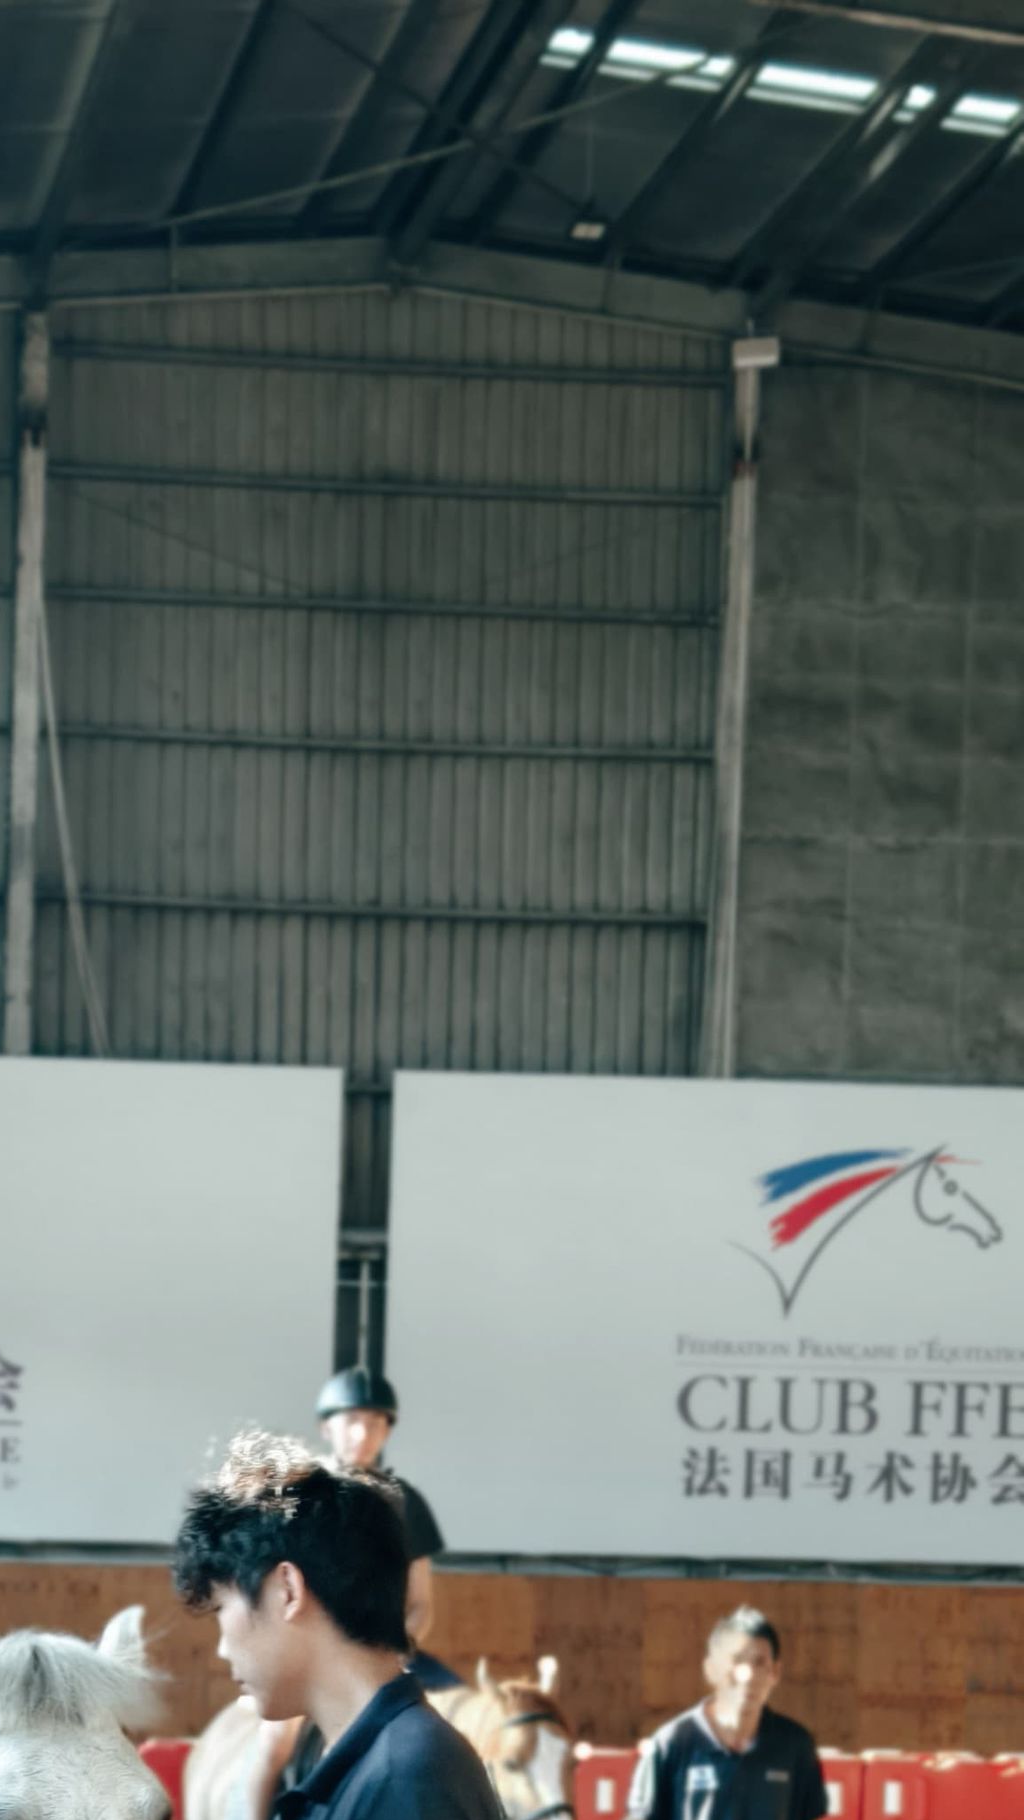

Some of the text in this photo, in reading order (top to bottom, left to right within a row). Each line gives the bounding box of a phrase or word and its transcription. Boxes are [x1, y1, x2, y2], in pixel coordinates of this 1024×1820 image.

[677, 1374, 1024, 1440] CLUB FFE
[682, 1446, 1024, 1505] 法国马术协会
